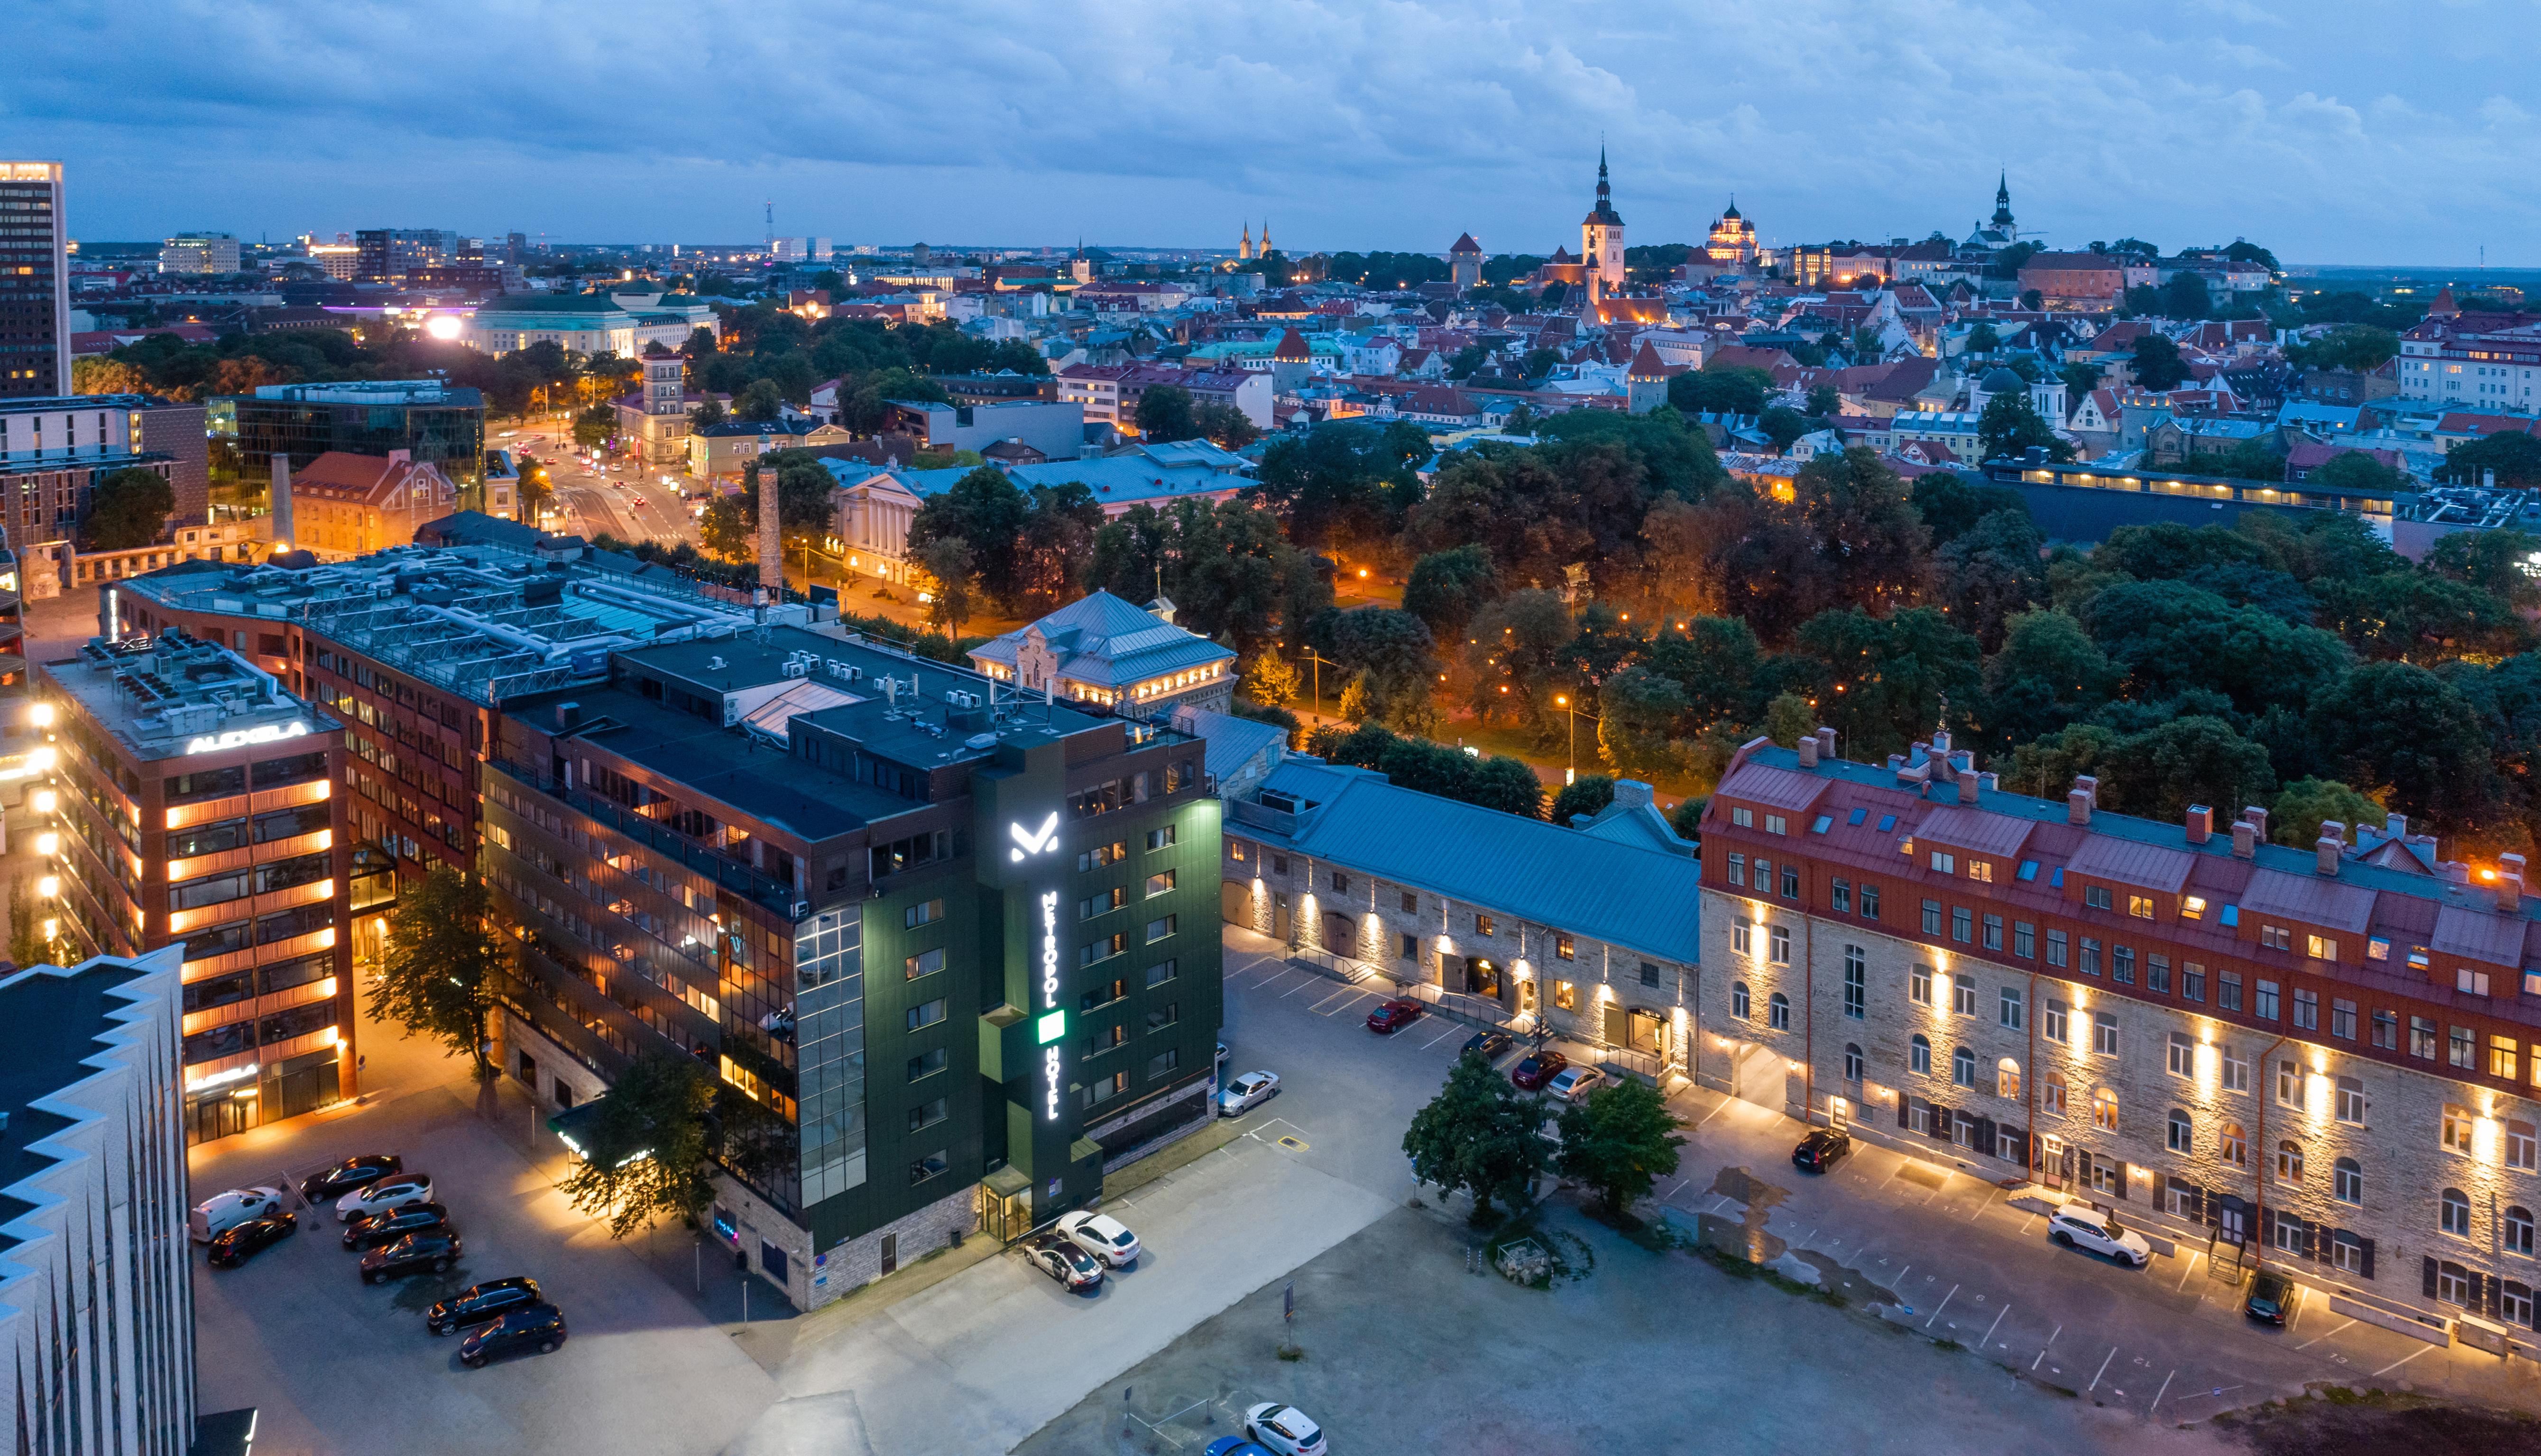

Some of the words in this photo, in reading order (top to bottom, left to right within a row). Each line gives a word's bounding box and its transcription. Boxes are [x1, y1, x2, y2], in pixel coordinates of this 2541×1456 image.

[187, 721, 307, 755] ALEXELA
[1042, 891, 1058, 1008] METROPOL
[1045, 1045, 1060, 1120] HOTEL
[1674, 1113, 1688, 1121] 22
[2329, 1353, 2348, 1364] 13
